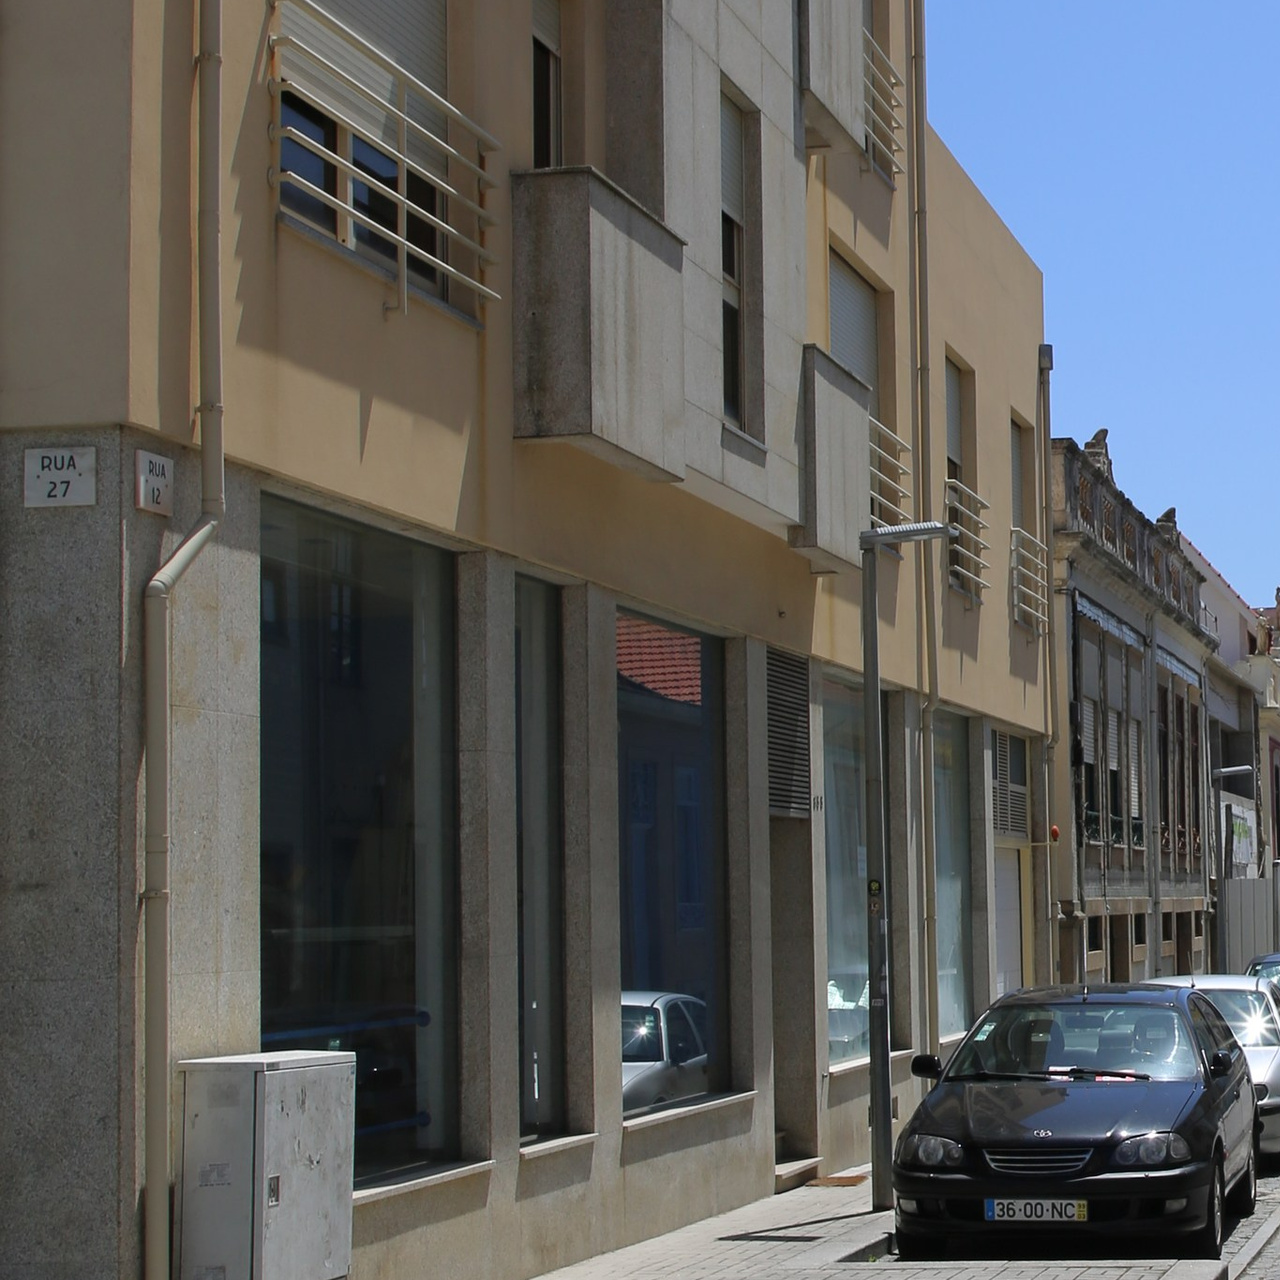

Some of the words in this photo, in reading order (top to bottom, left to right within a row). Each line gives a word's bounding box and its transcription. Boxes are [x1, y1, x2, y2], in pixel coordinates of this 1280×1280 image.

[41, 455, 76, 472] RUA
[148, 460, 167, 480] RUA
[47, 481, 71, 498] 27
[151, 487, 161, 505] 12
